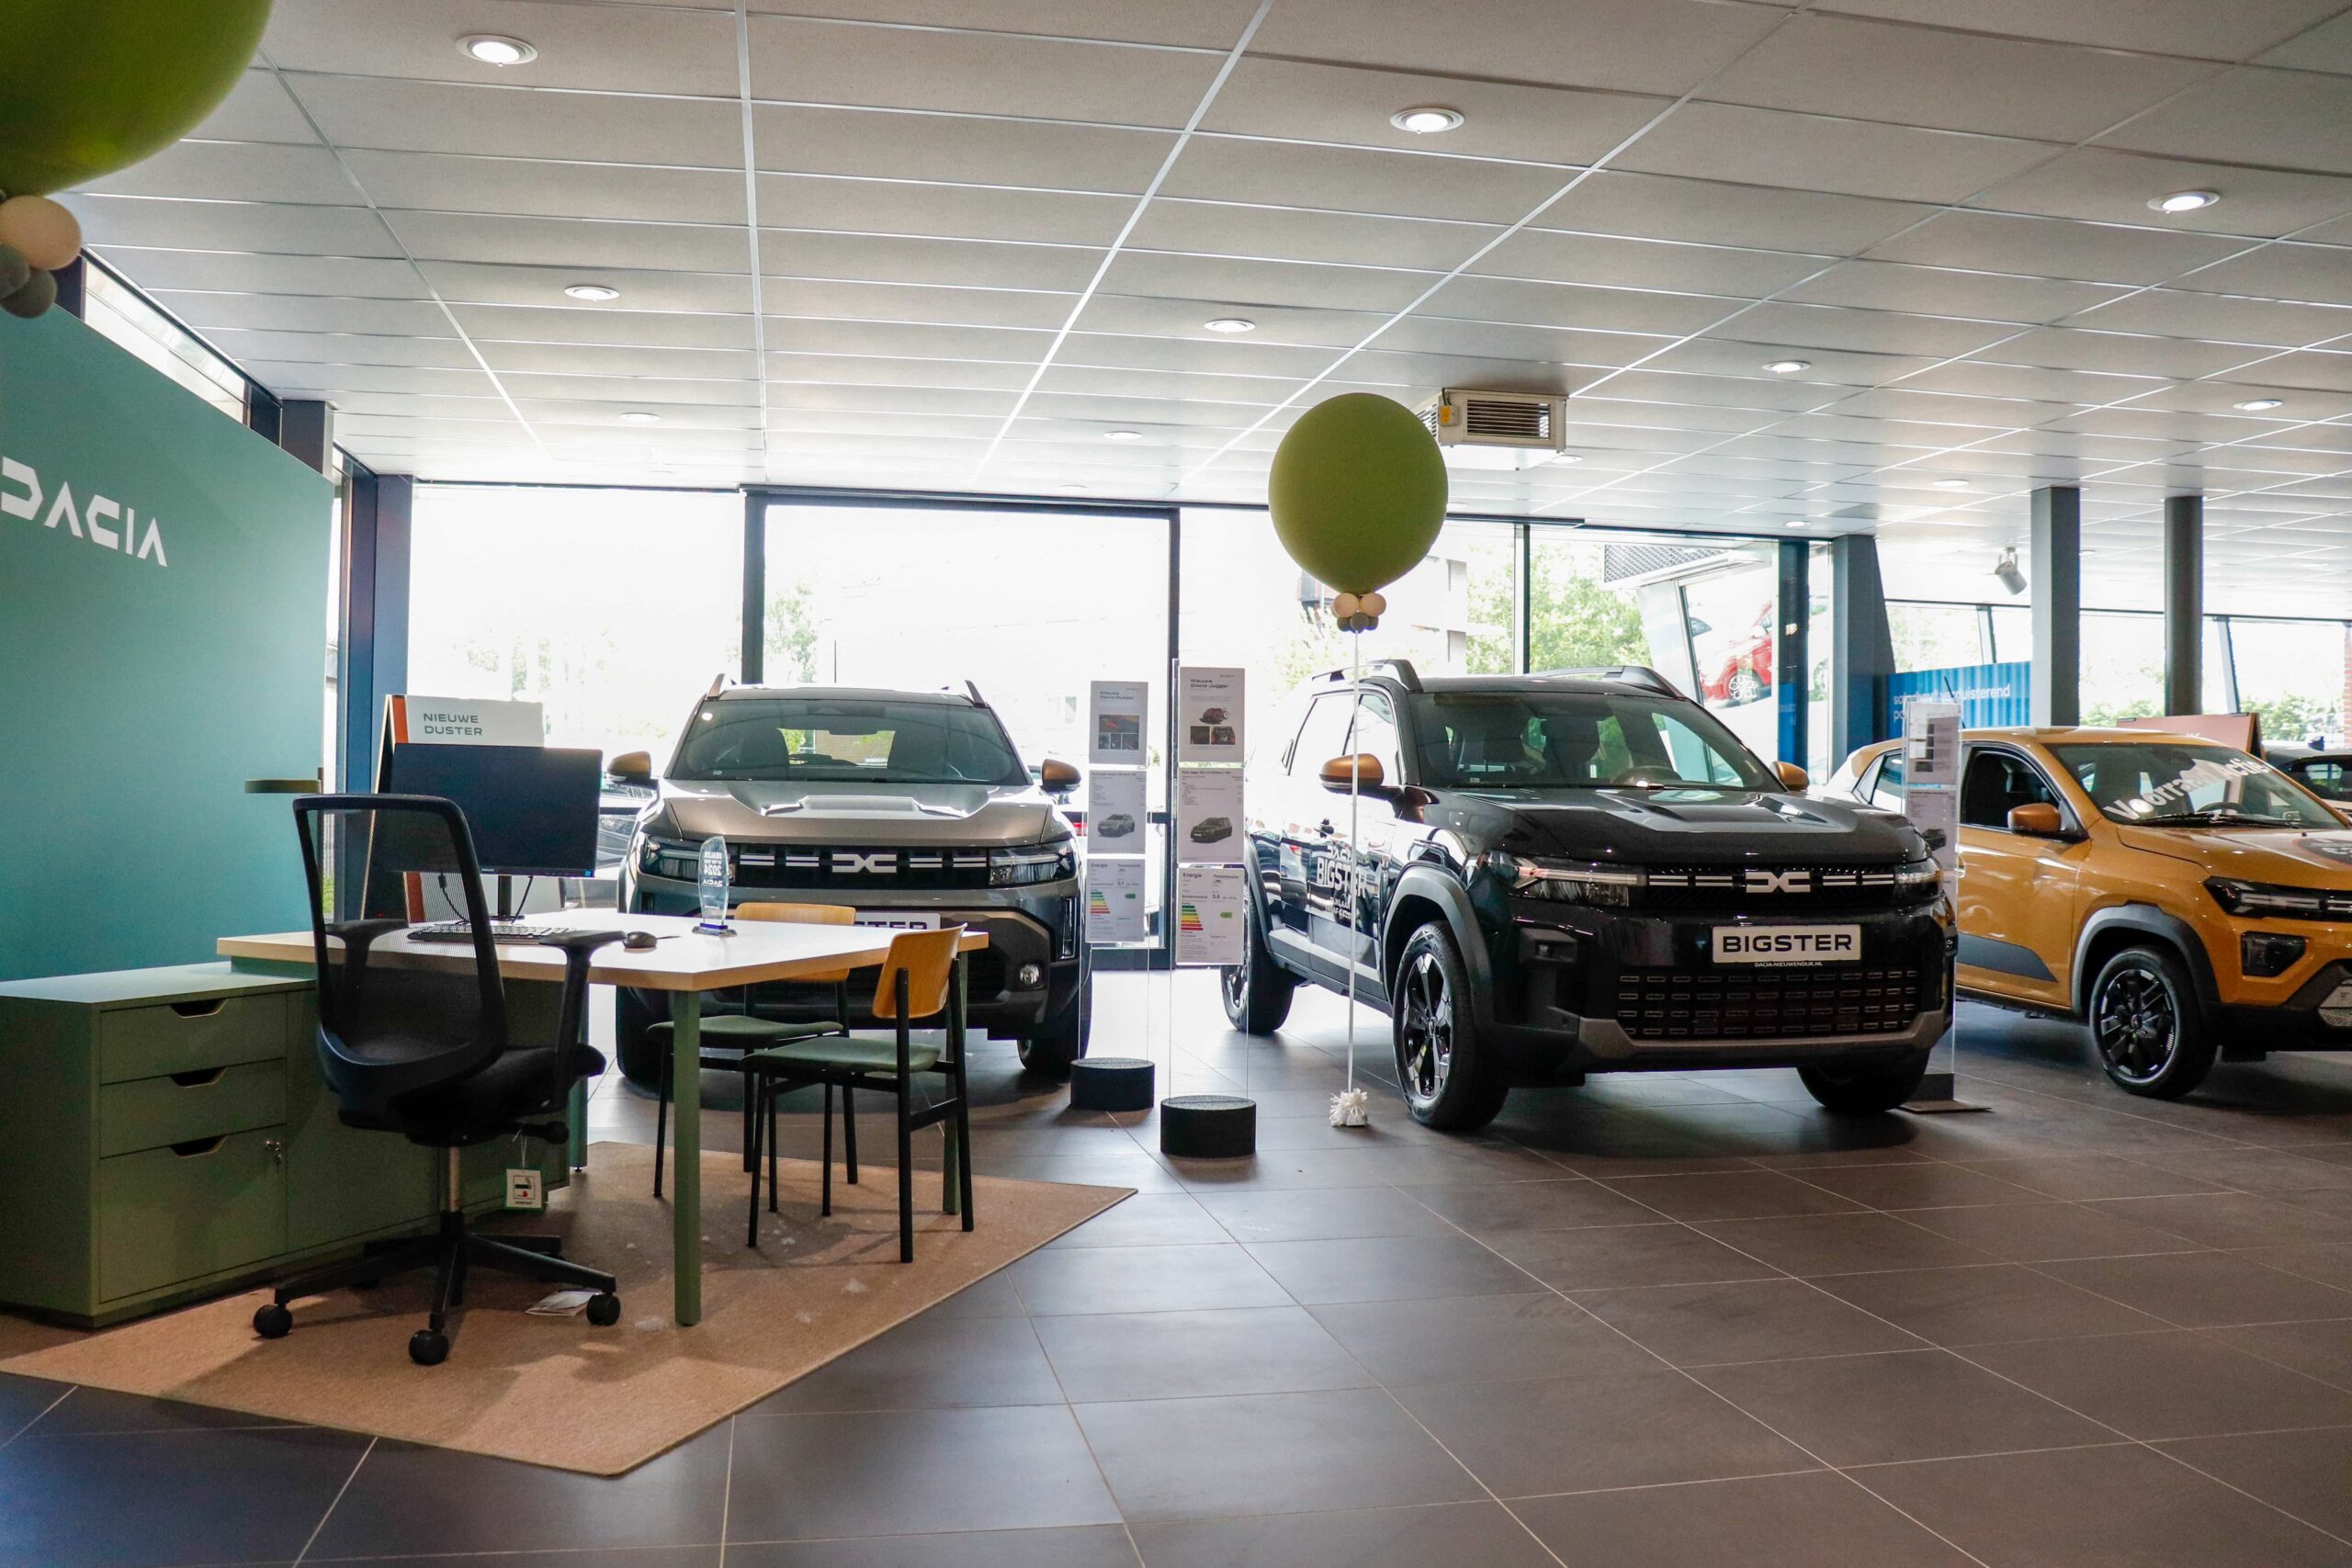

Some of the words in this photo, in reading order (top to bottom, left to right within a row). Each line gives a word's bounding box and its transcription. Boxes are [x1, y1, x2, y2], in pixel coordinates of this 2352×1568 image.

[1, 456, 168, 568] DACIA
[423, 713, 479, 724] NIEUWE
[424, 726, 483, 736] DUSTER
[1723, 934, 1852, 953] BIGSTER
